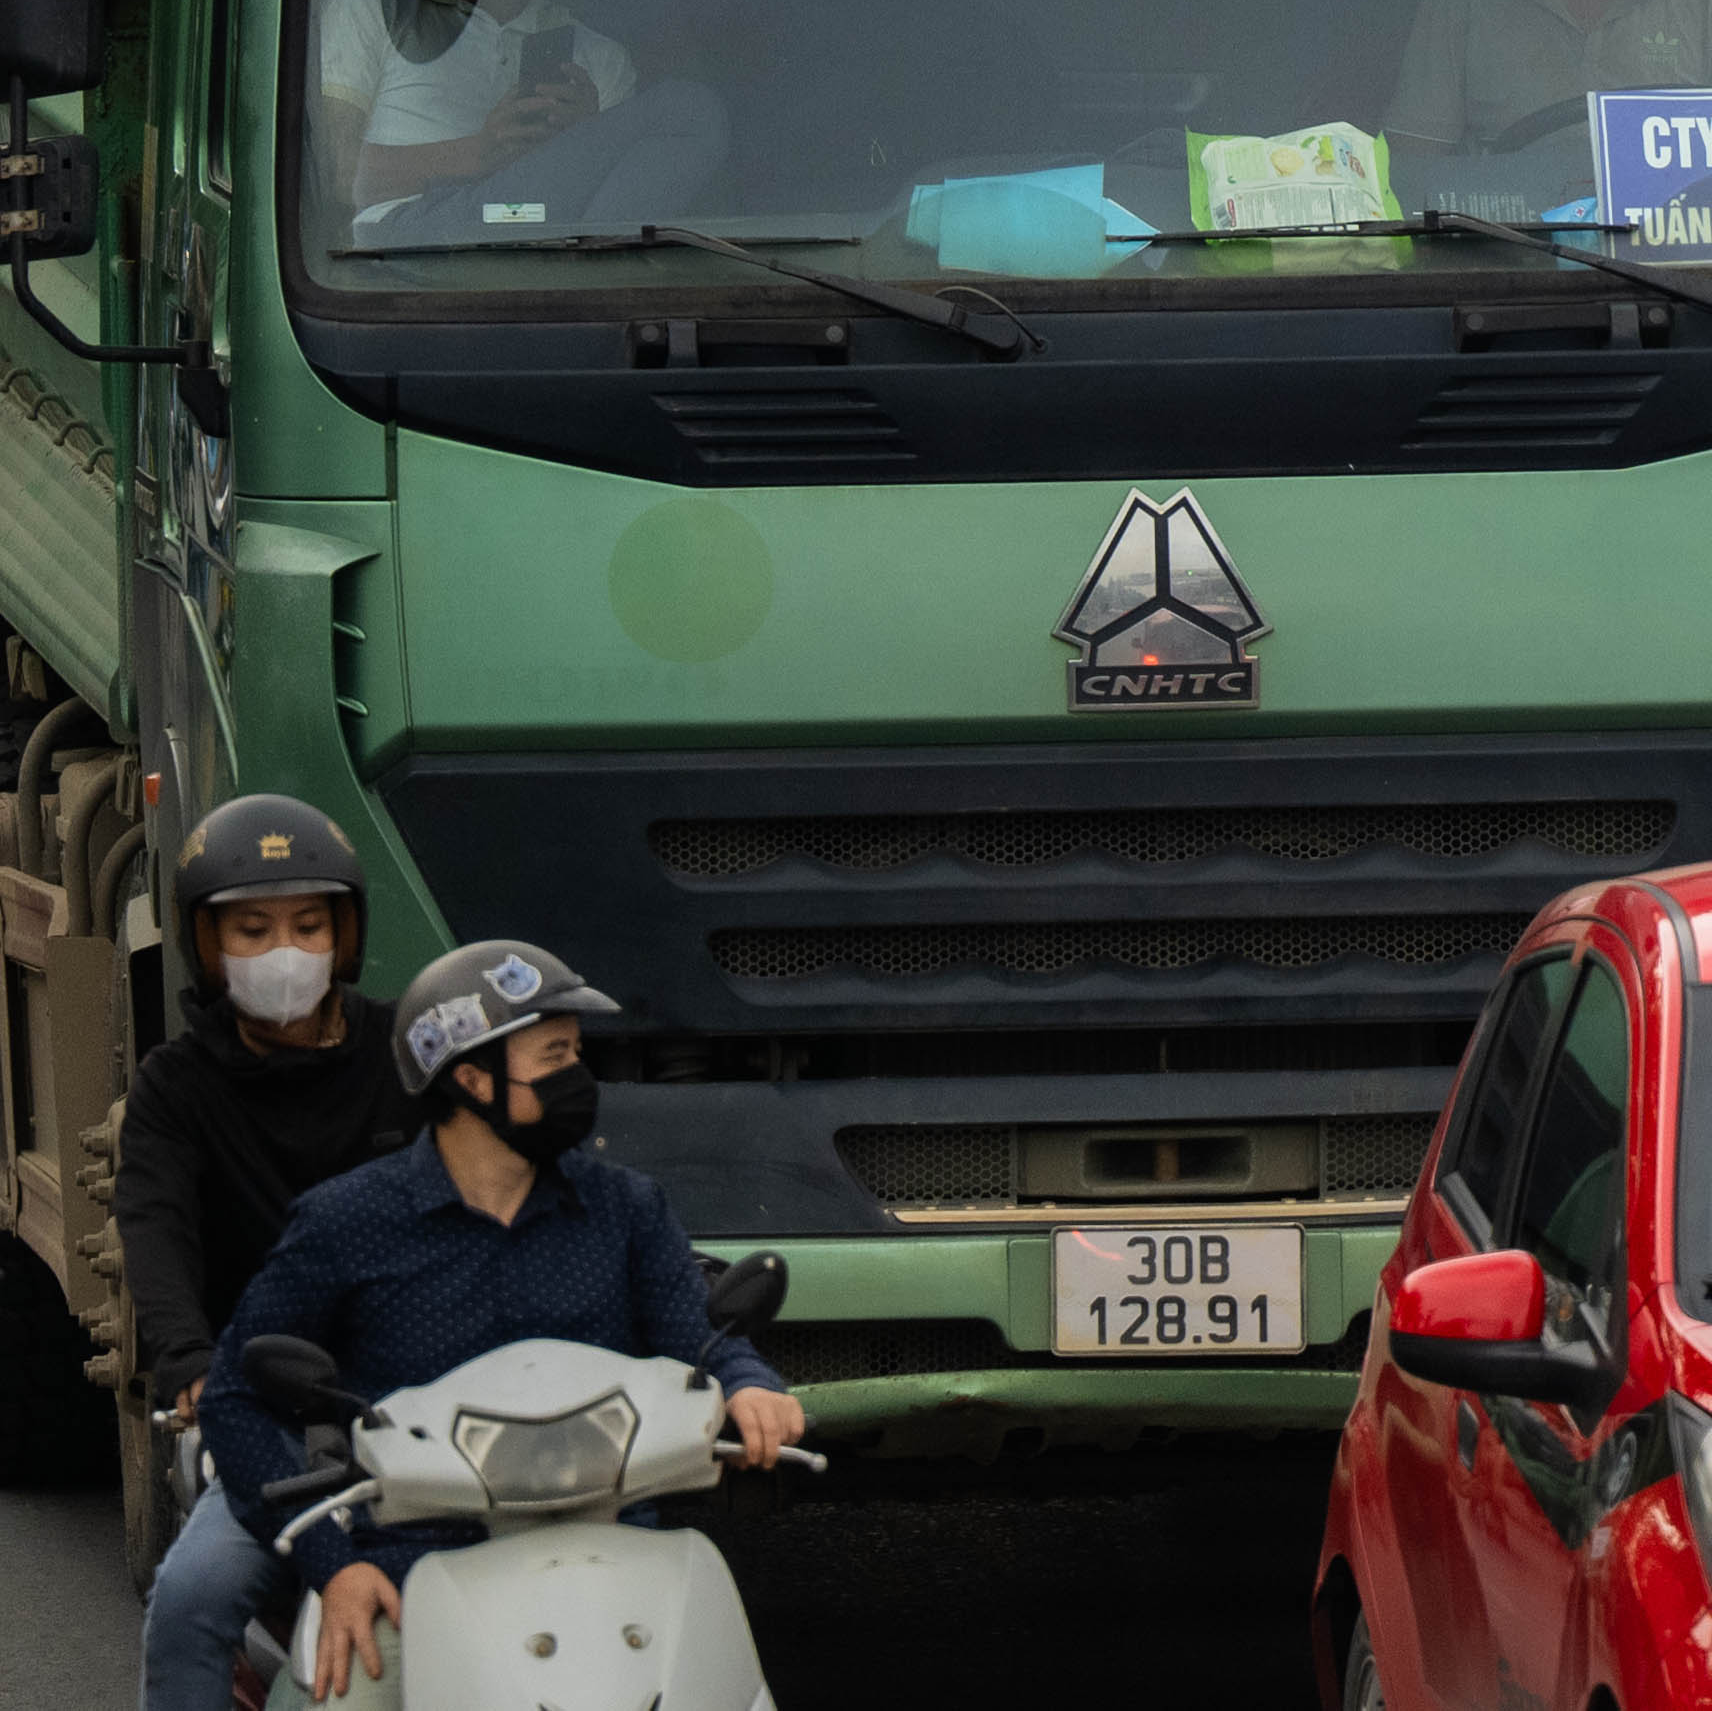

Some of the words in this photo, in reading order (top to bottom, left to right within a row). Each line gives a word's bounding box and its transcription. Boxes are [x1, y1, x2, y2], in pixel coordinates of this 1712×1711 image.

[1625, 193, 1712, 246] TUẤN
[1081, 672, 1246, 696] CNHTC
[1127, 1235, 1230, 1285] 30B
[1089, 1294, 1269, 1345] 128.91
